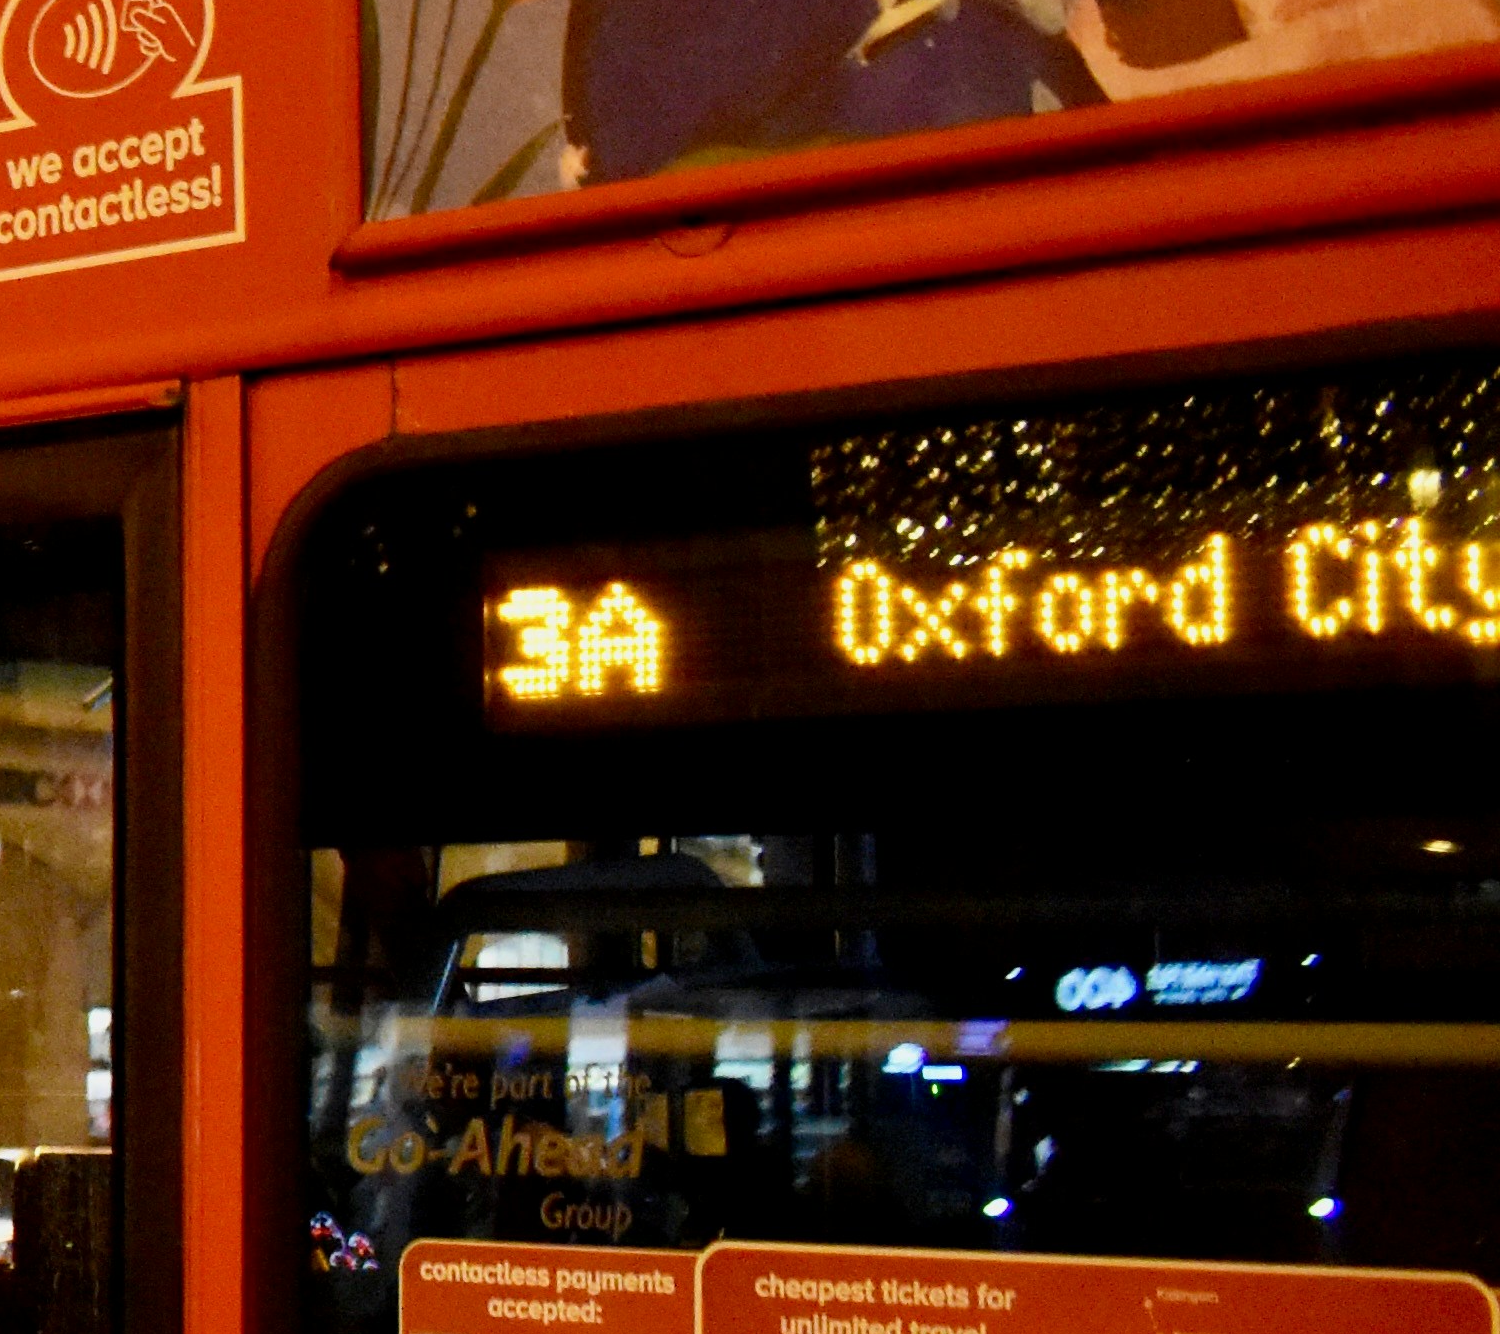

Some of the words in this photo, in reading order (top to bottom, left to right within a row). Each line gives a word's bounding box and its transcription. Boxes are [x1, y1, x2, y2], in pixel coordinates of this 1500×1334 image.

[5, 151, 63, 190] we
[72, 116, 205, 172] accept
[832, 531, 1230, 666] Oxford
[498, 583, 659, 697] 3A
[540, 1192, 633, 1241] Group
[419, 1260, 550, 1288] contactless
[556, 1268, 676, 1296] payments
[754, 1272, 876, 1305] cheapest
[881, 1279, 969, 1309] tickets
[977, 1282, 1017, 1310] for
[487, 1296, 604, 1325] accepted:
